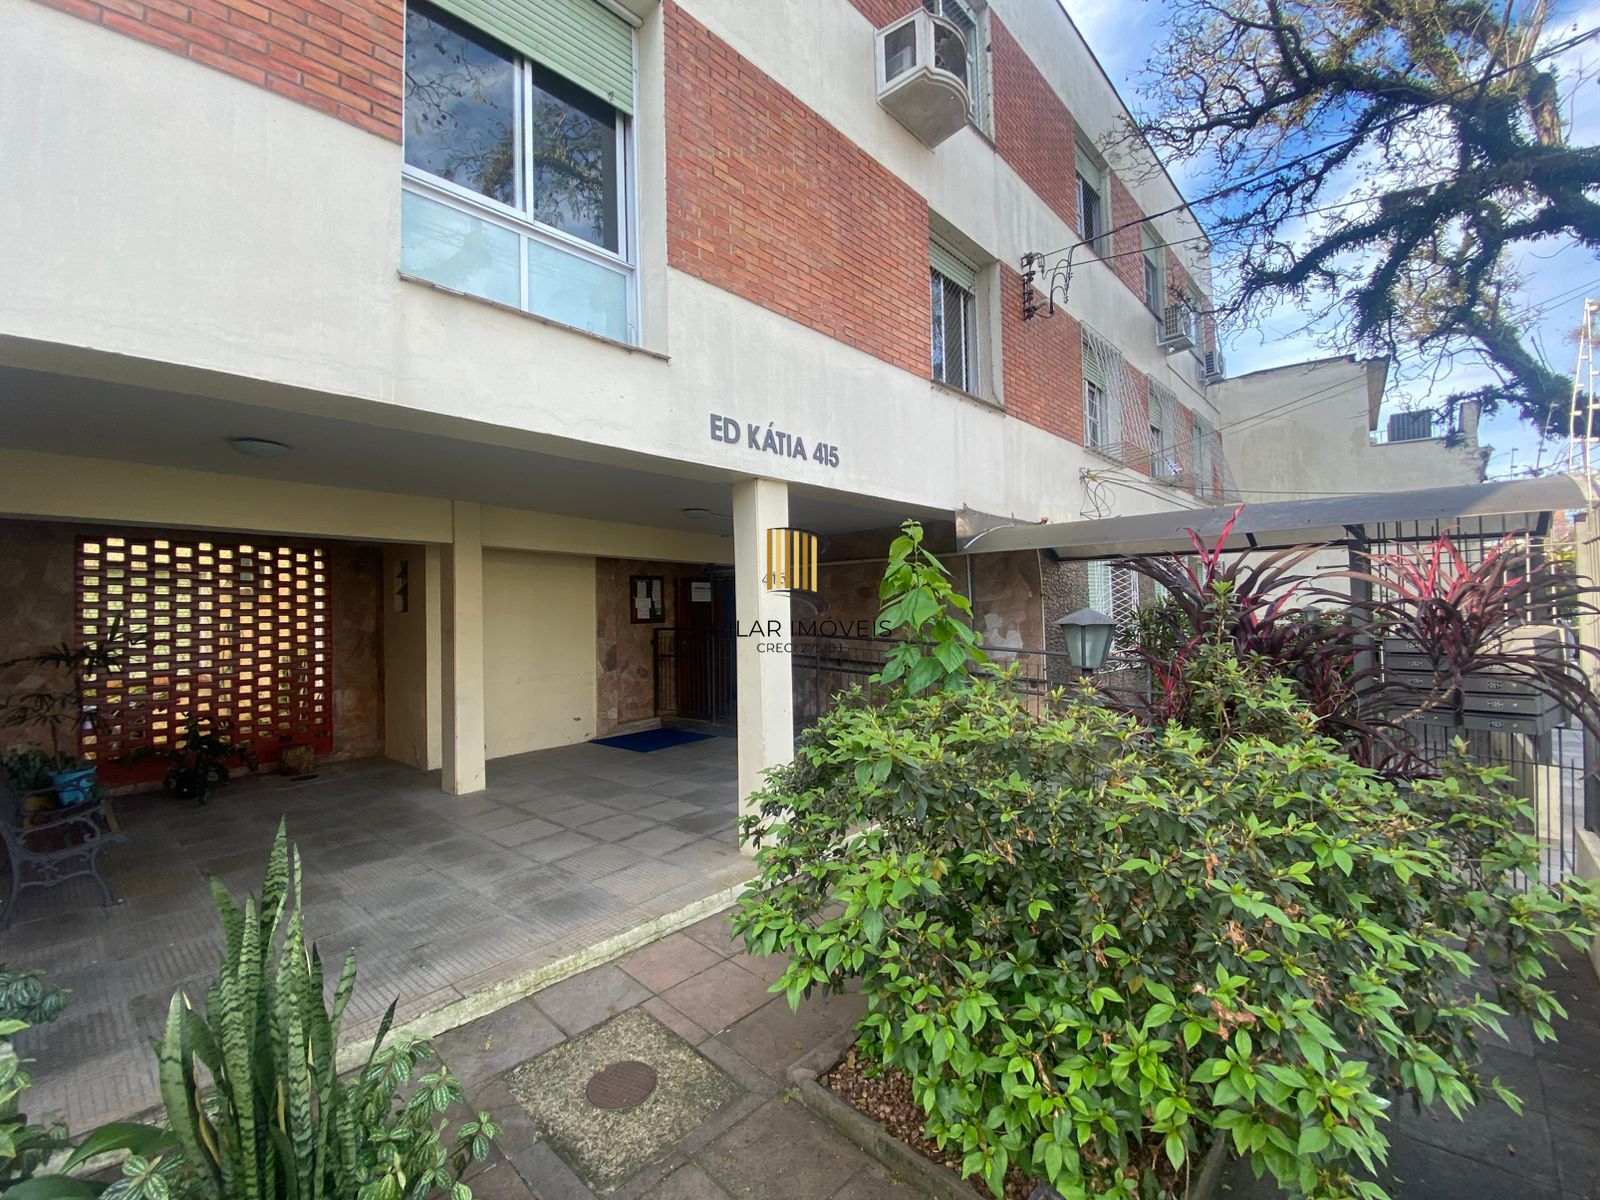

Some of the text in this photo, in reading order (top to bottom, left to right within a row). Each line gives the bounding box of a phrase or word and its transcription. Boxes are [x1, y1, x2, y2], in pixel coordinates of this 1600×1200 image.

[710, 413, 839, 468] ED KÁTIA 415
